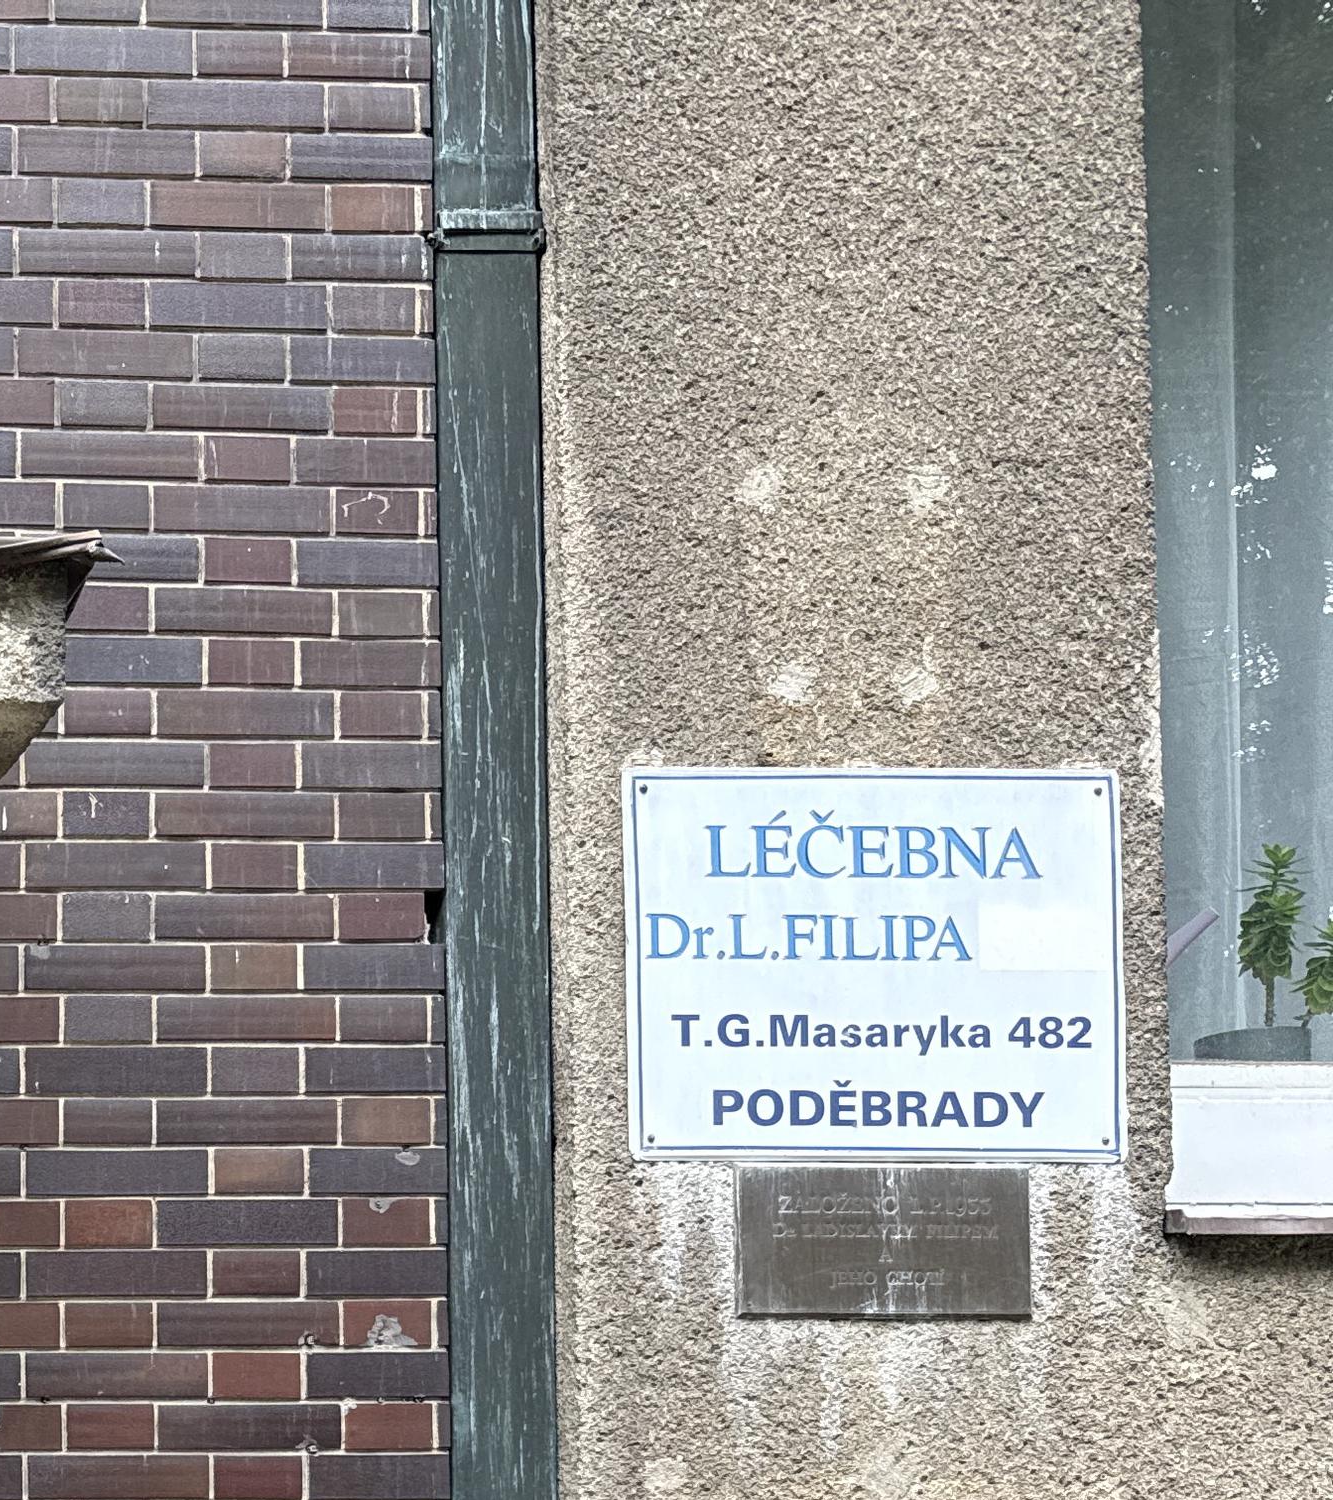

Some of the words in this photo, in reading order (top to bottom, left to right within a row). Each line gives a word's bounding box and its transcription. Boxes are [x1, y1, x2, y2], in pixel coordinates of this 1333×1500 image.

[704, 810, 1044, 880] LÉČEBNA
[671, 1013, 993, 1056] T.G.Masaryka
[1007, 1016, 1094, 1050] 482
[712, 1080, 1046, 1129] PODĚBRADY
